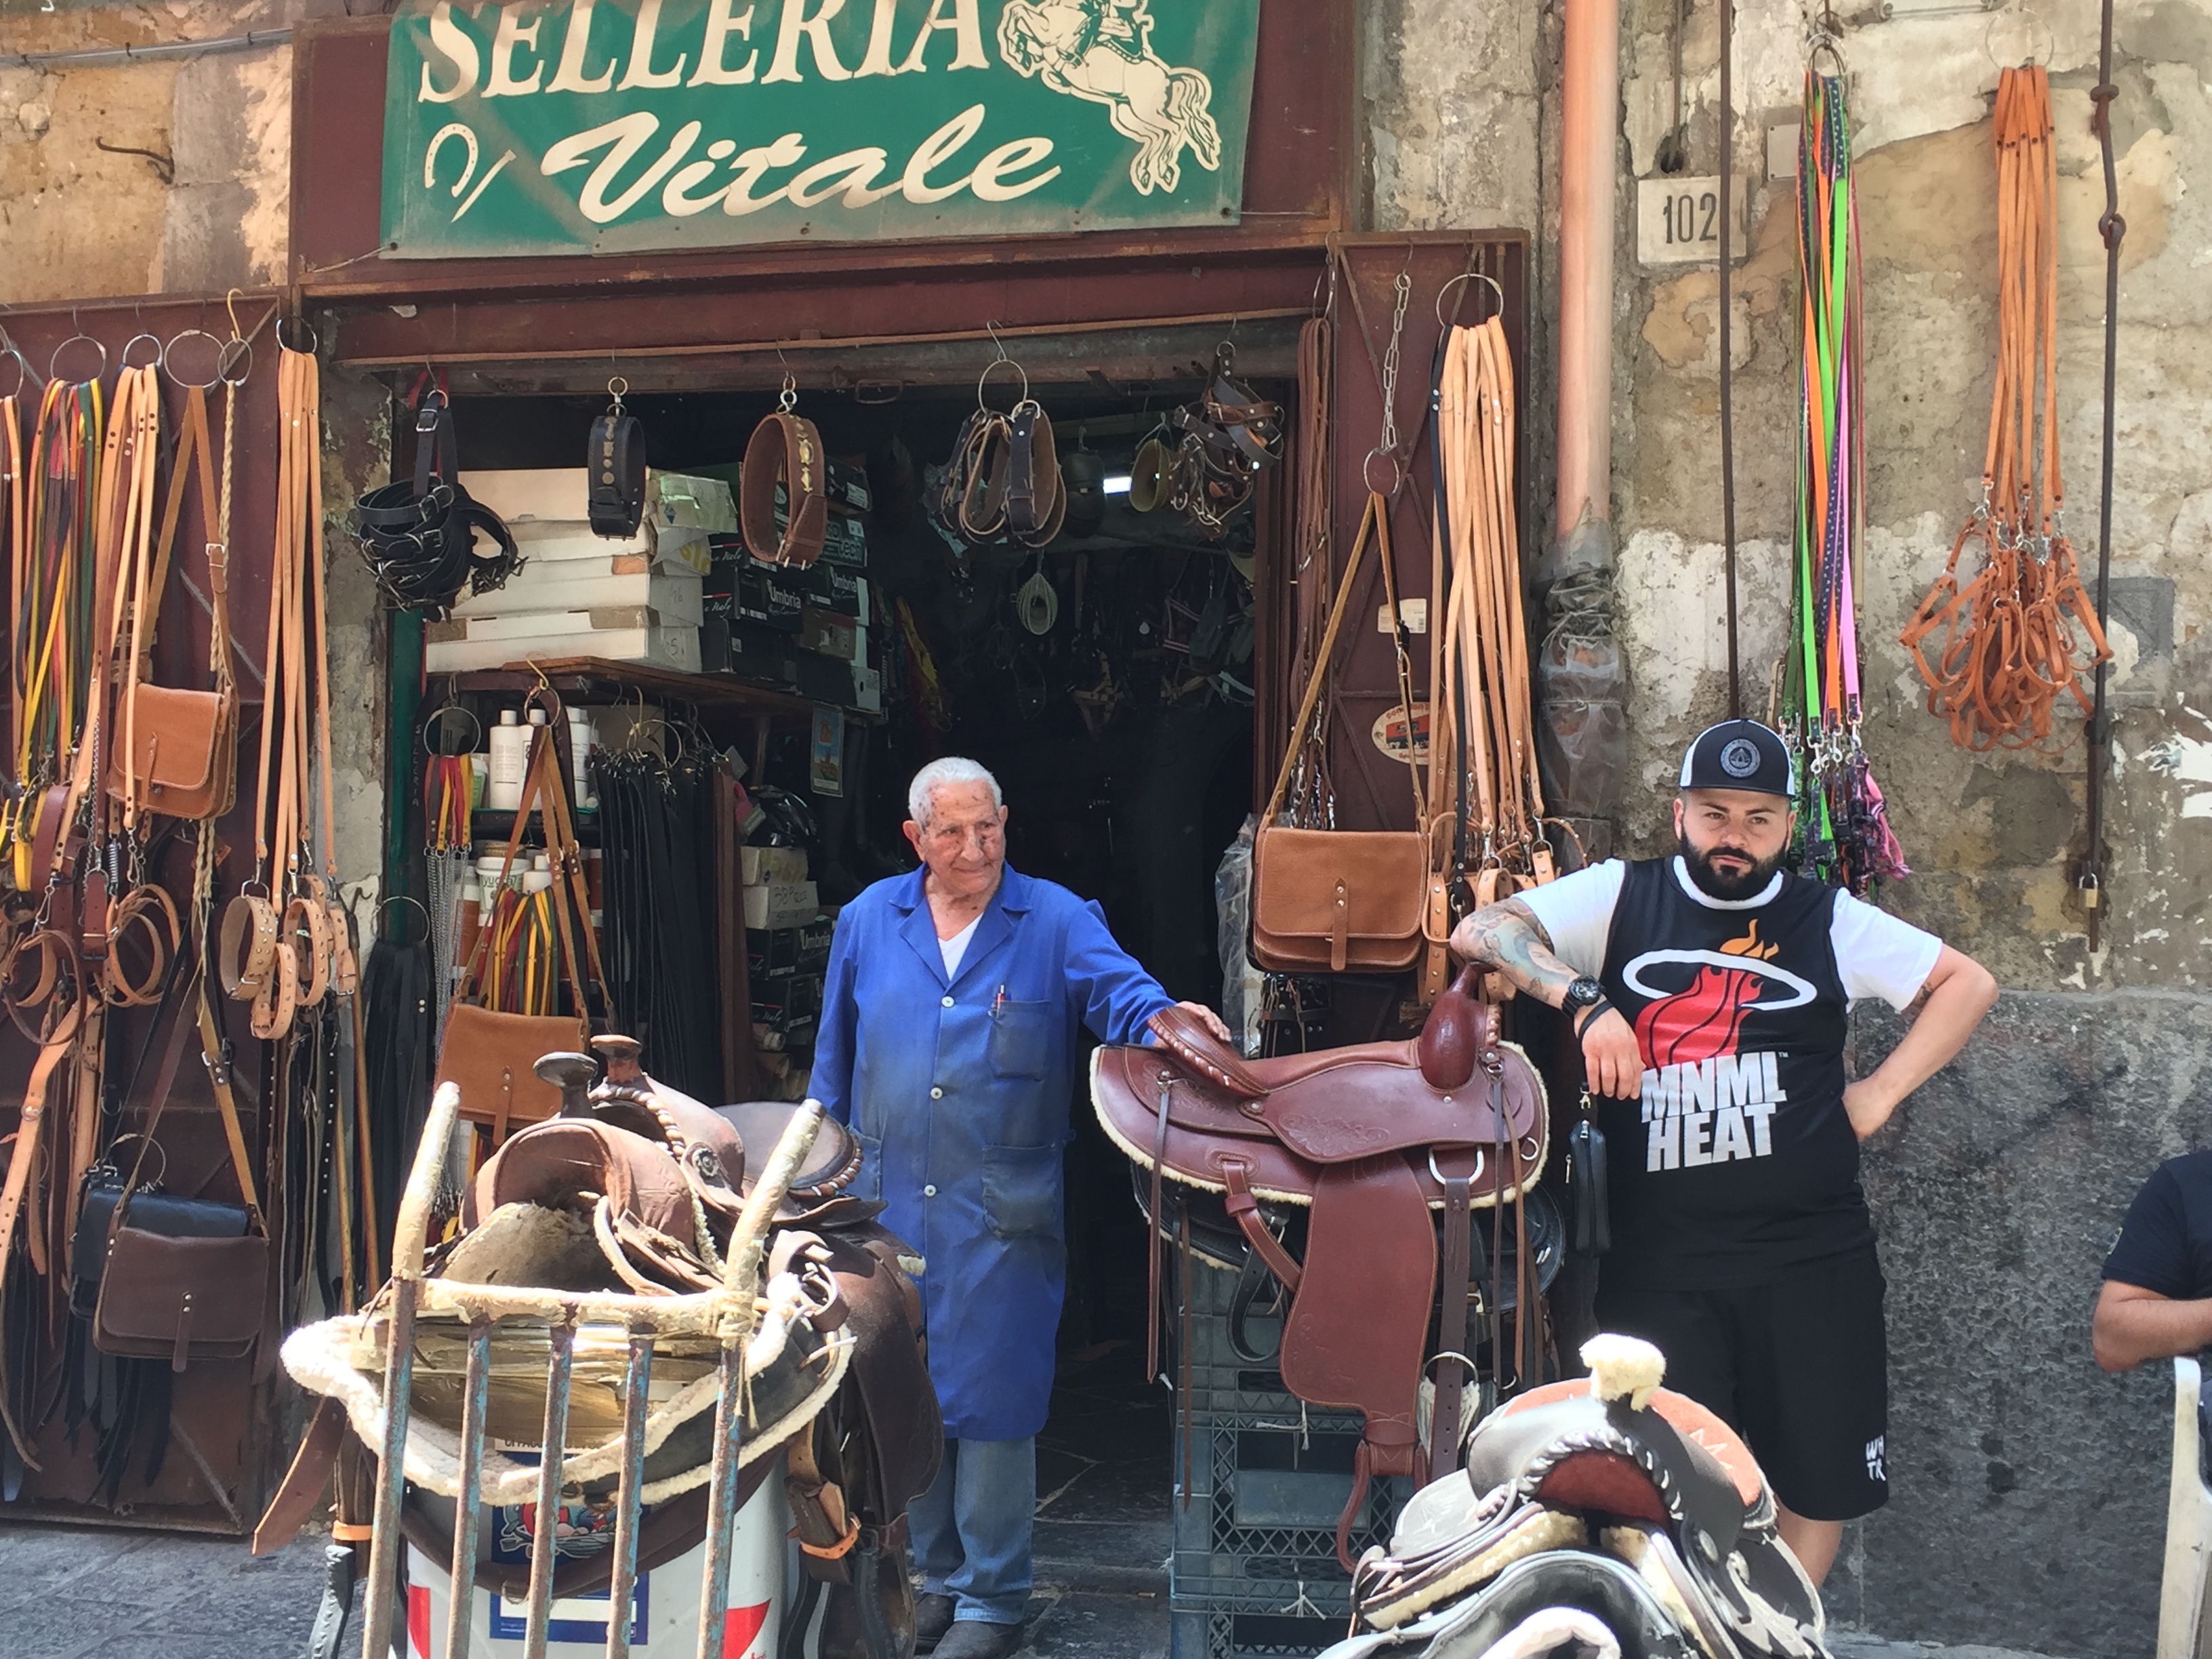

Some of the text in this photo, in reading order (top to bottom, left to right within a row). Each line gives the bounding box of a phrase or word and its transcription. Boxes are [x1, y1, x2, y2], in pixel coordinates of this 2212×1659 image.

[417, 0, 990, 104] SELLERIA
[541, 104, 1061, 223] Vitale
[1662, 192, 1718, 245] 102
[766, 578, 802, 609] Umbria
[830, 565, 857, 593] Umbria
[799, 928, 831, 950] Umbria
[1641, 1052, 1787, 1123] MNML
[1645, 1102, 1777, 1173] HEAT
